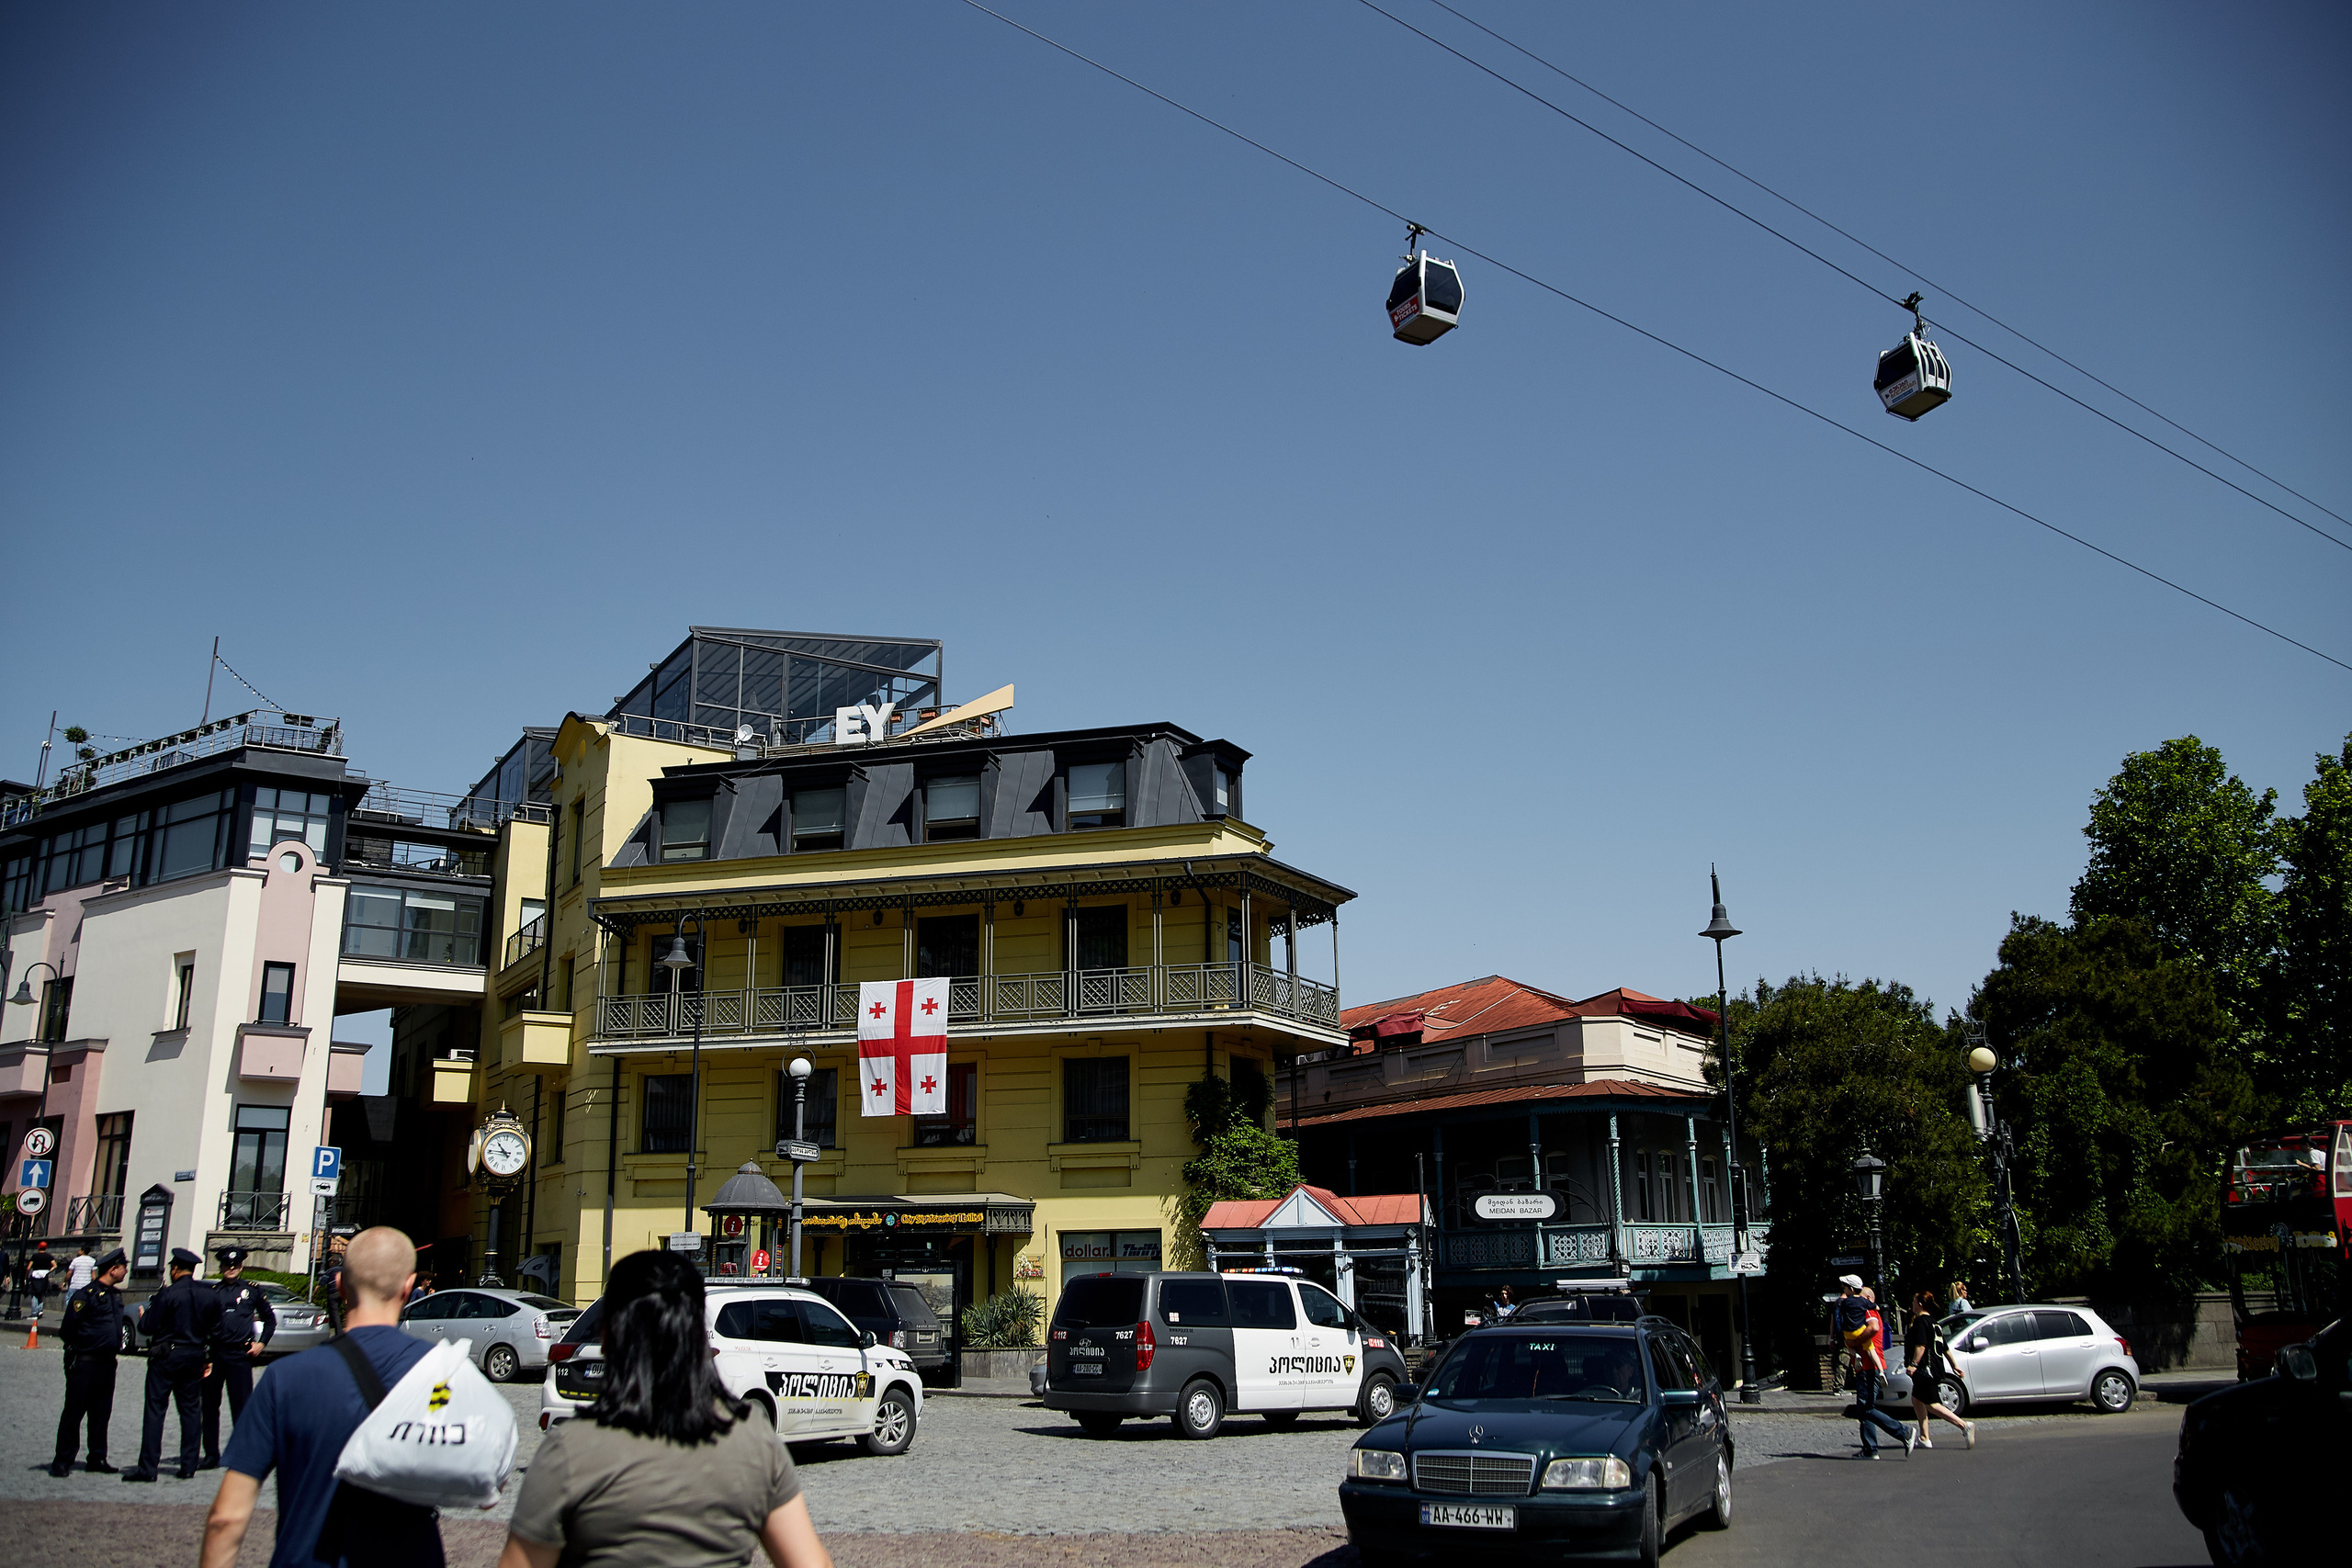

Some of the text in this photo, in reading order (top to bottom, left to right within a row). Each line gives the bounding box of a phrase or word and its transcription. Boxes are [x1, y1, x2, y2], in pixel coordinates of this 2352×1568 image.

[1396, 302, 1411, 315] TOURS
[1399, 304, 1418, 320] TICKETS
[836, 703, 896, 745] EY
[318, 1150, 335, 1175] P
[900, 1213, 916, 1225] City
[1057, 1331, 1067, 1339] 112
[1115, 1330, 1134, 1339] 7627
[1170, 1337, 1188, 1345] 7627
[1374, 1339, 1385, 1348] 112
[1069, 1347, 1105, 1357] პოლიცია
[1269, 1356, 1341, 1374] პოლიცია
[557, 1368, 569, 1376] 112
[778, 1373, 857, 1398] პოლიცია
[388, 1421, 466, 1446] כוורת
[1433, 1506, 1503, 1525] AA-466-WW
